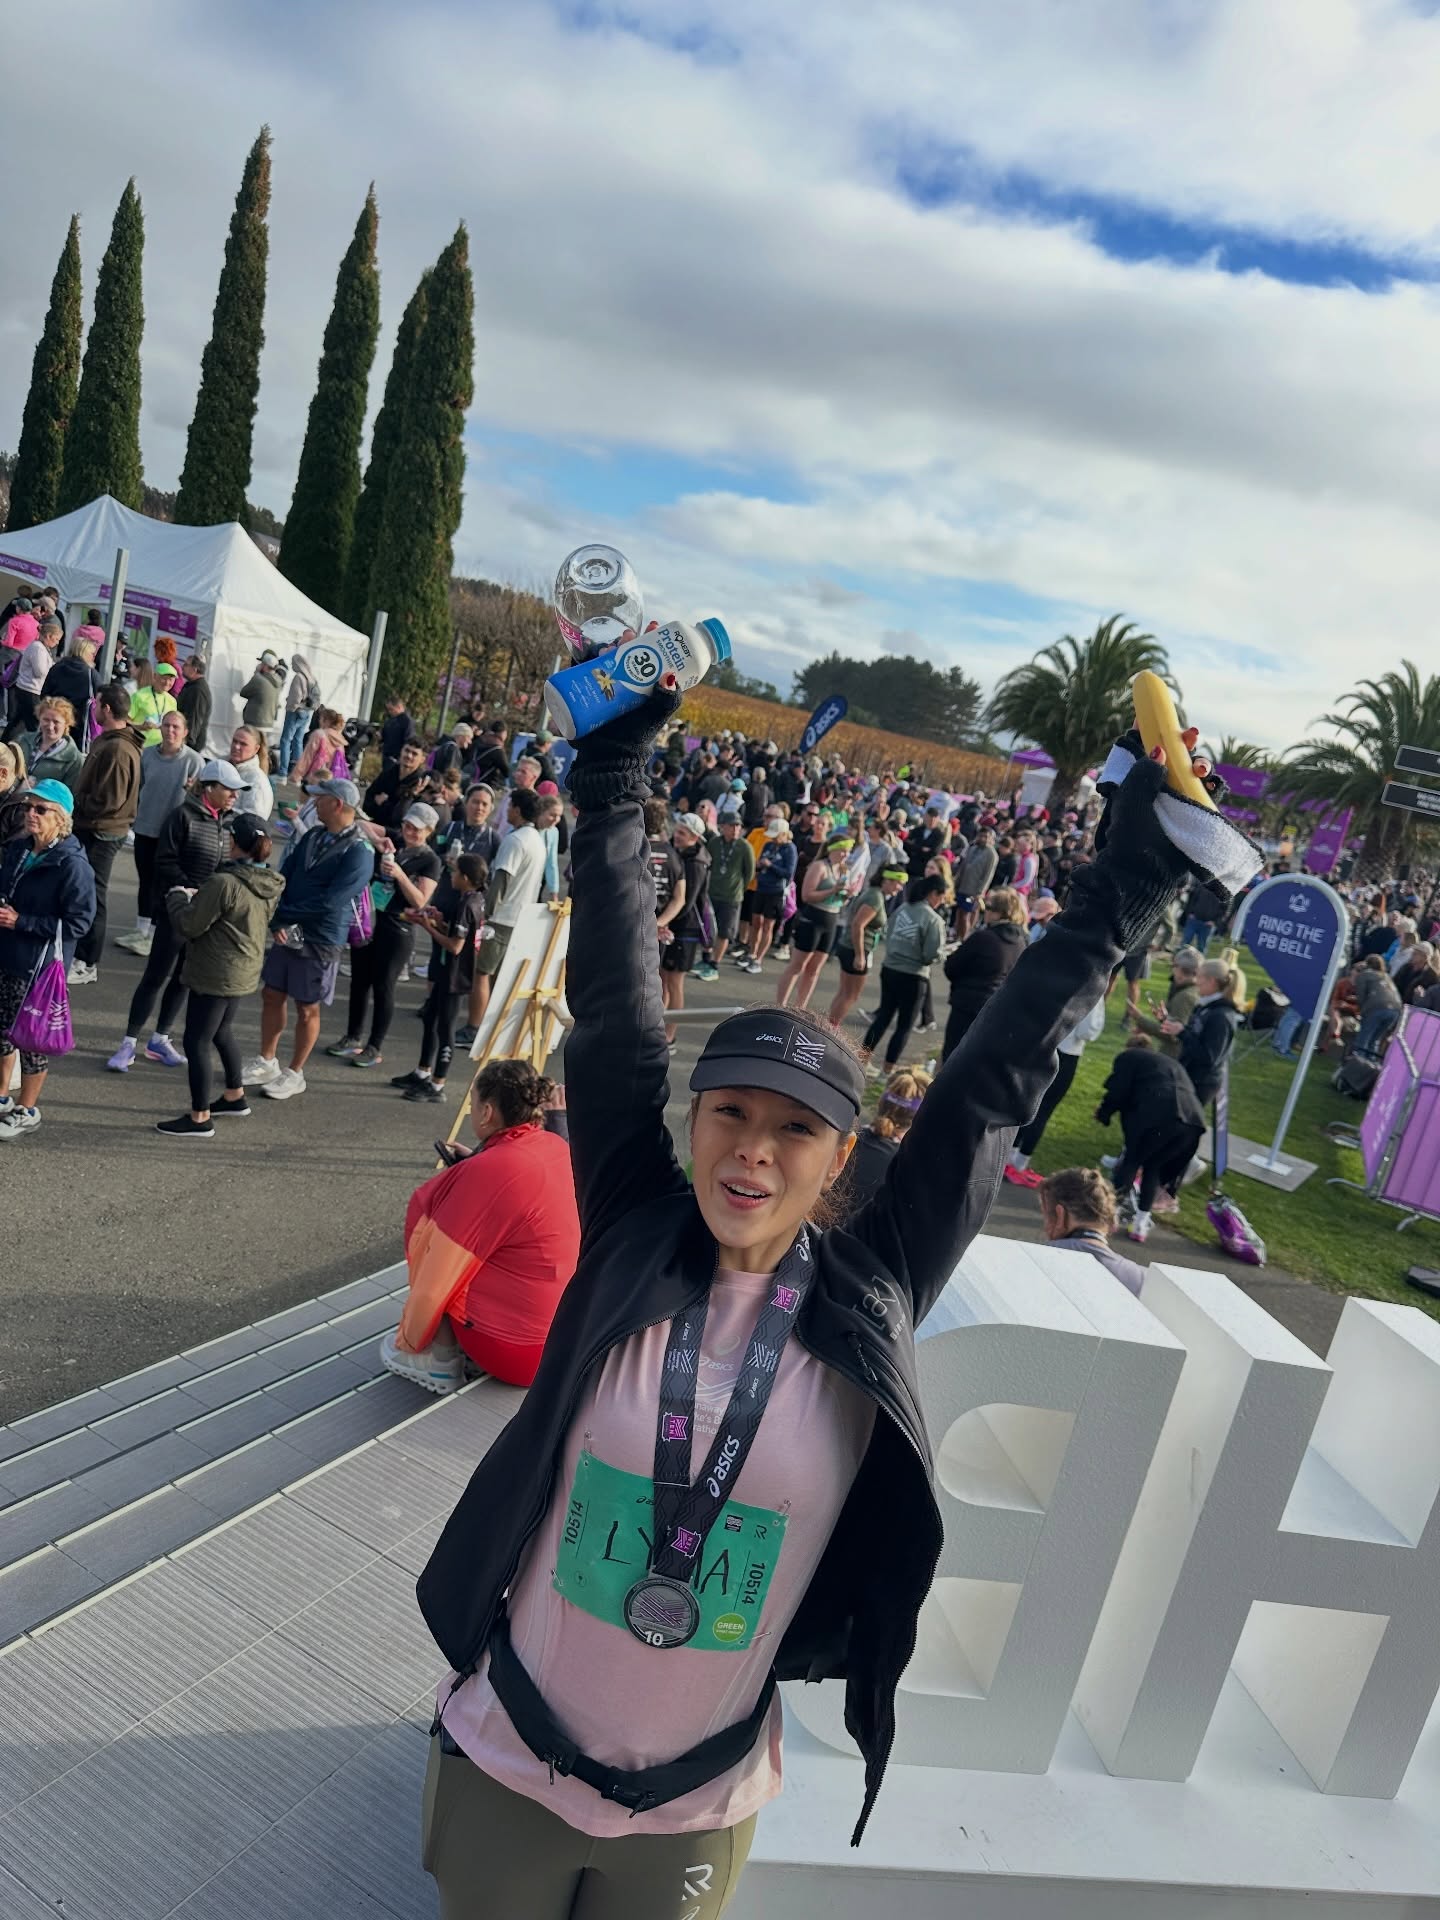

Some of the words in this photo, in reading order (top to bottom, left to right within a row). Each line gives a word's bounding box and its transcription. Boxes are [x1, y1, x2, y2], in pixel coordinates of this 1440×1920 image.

[657, 628, 686, 672] Protein
[674, 630, 693, 659] ROKEBY
[634, 651, 657, 678] 30
[1258, 914, 1294, 936] RING
[1296, 923, 1327, 944] THE
[1257, 931, 1279, 950] PB
[1278, 937, 1313, 960] BELL
[564, 1500, 584, 1545] 10514
[741, 1562, 767, 1605] 10514
[643, 1630, 664, 1646] 10
[717, 1621, 744, 1630] GREEN
